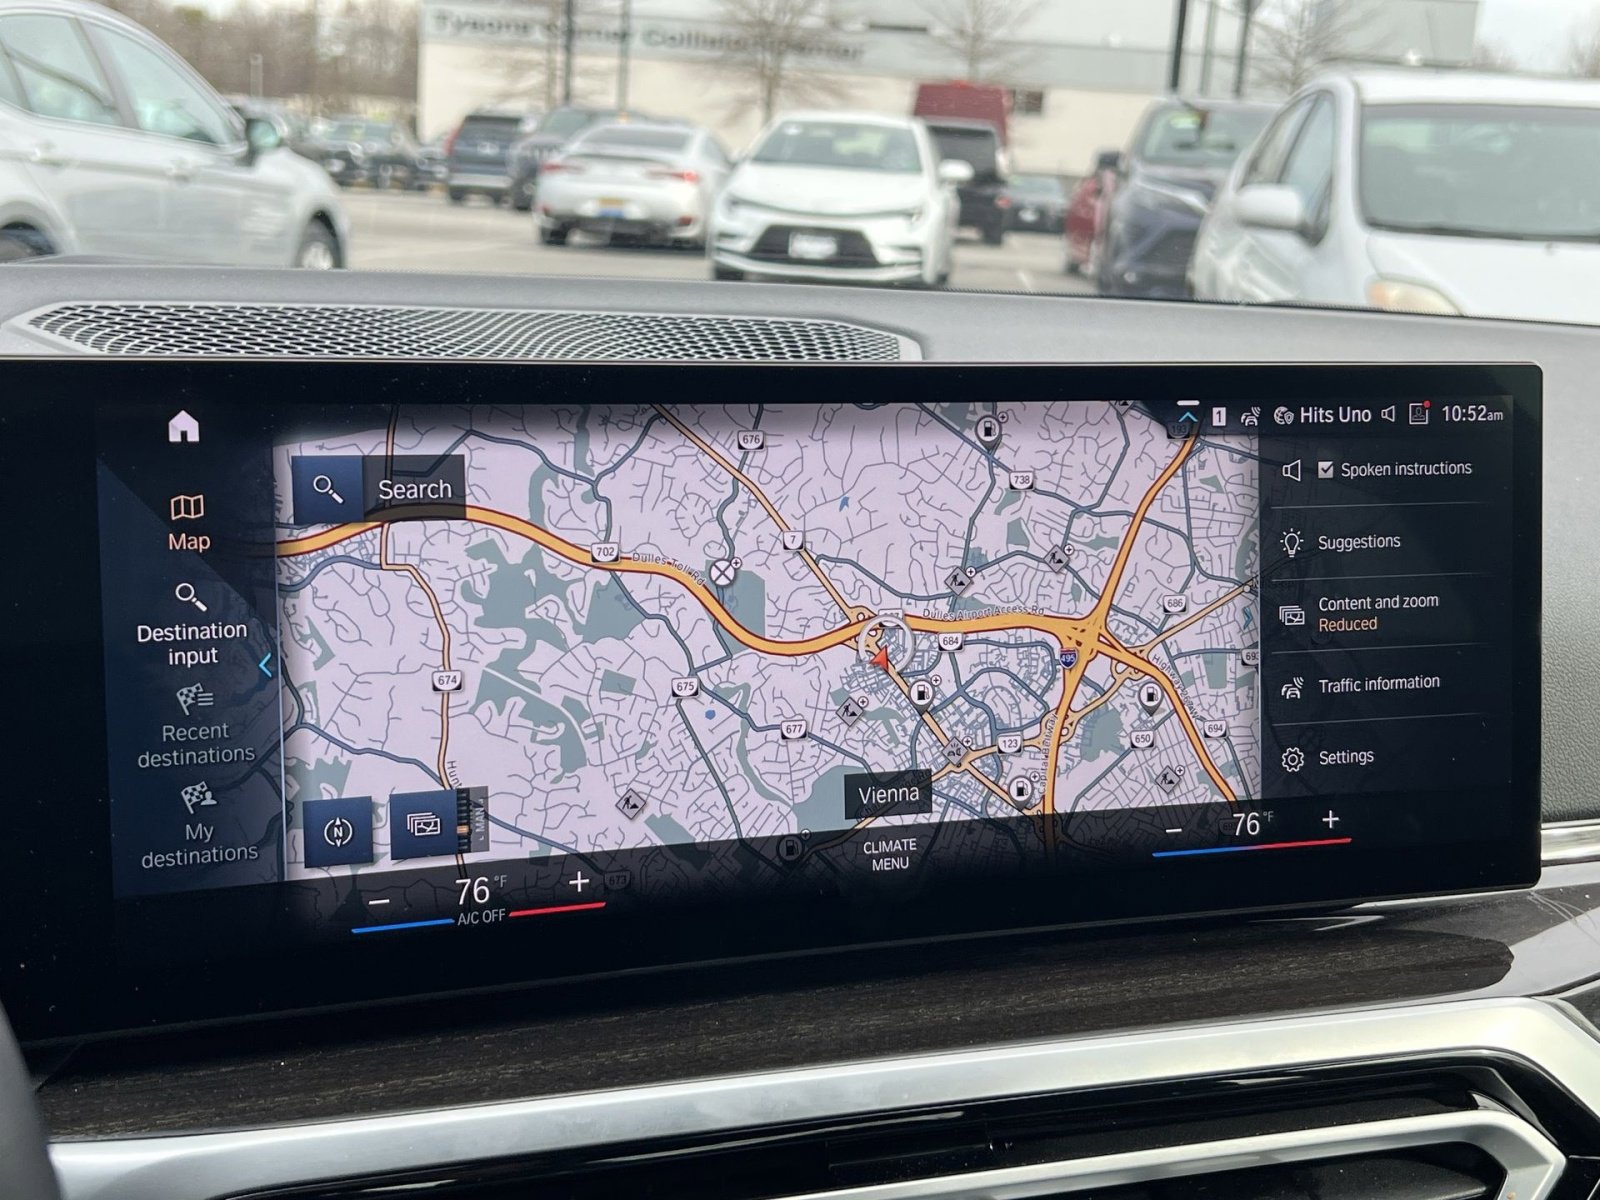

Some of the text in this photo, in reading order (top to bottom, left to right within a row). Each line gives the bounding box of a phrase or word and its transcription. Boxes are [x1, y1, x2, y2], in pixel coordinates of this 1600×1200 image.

[1300, 406, 1372, 423] Hits Uno
[1442, 404, 1504, 422] 10:52am
[742, 433, 760, 445] 676
[1341, 461, 1473, 480] Spoken instructions
[1014, 475, 1030, 485] 738
[378, 479, 452, 500] Search
[168, 532, 211, 553] Map
[596, 546, 615, 557] 702
[1318, 534, 1401, 553] Suggestions
[632, 552, 705, 586] Dulles Toll Rd
[922, 604, 1045, 620] Dulles Airport Access Rd
[1167, 600, 1184, 609] 686
[1318, 594, 1439, 612] Content and zoom
[137, 621, 247, 643] Destination
[1319, 616, 1378, 632] Reduced
[942, 636, 959, 646] 684
[168, 647, 219, 669] input
[1060, 655, 1076, 663] 495
[438, 675, 457, 686] 674
[1152, 654, 1184, 690] Highway
[676, 681, 695, 692] 675
[1318, 674, 1440, 693] Traffic information
[162, 722, 230, 742] Recent
[786, 724, 803, 735] 677
[1207, 724, 1223, 734] 694
[1002, 739, 1018, 749] 123
[1135, 734, 1151, 744] 650
[138, 746, 256, 768] destinations
[1319, 749, 1375, 766] Settings
[1038, 758, 1049, 794] Capital
[858, 786, 920, 805] Vienna
[1232, 811, 1260, 836] 76
[185, 823, 214, 843] My
[863, 837, 917, 855] CLIMATE
[141, 846, 259, 869] destinations
[872, 856, 909, 871] MENU
[455, 876, 490, 905] 76
[457, 908, 506, 926] A/C OFF
